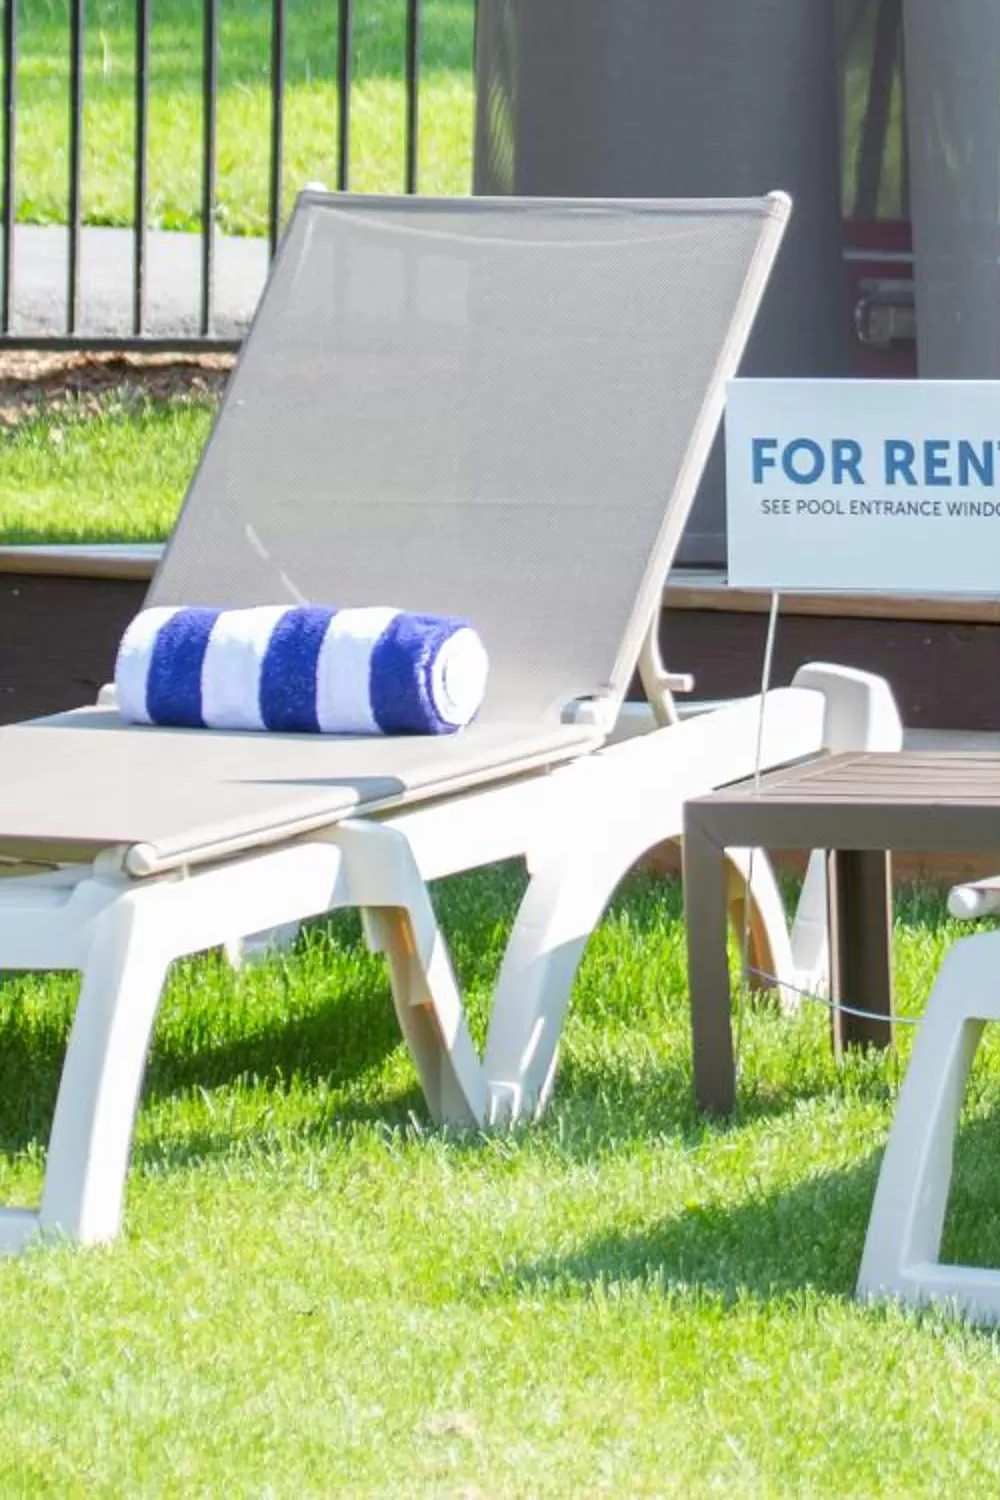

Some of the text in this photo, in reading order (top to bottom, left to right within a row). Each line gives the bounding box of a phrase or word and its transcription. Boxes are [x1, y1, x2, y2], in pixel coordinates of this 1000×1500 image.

[751, 437, 865, 485] FOR
[761, 499, 791, 515] SEE
[797, 499, 845, 515] POOL
[849, 500, 942, 517] ENTRANCE
